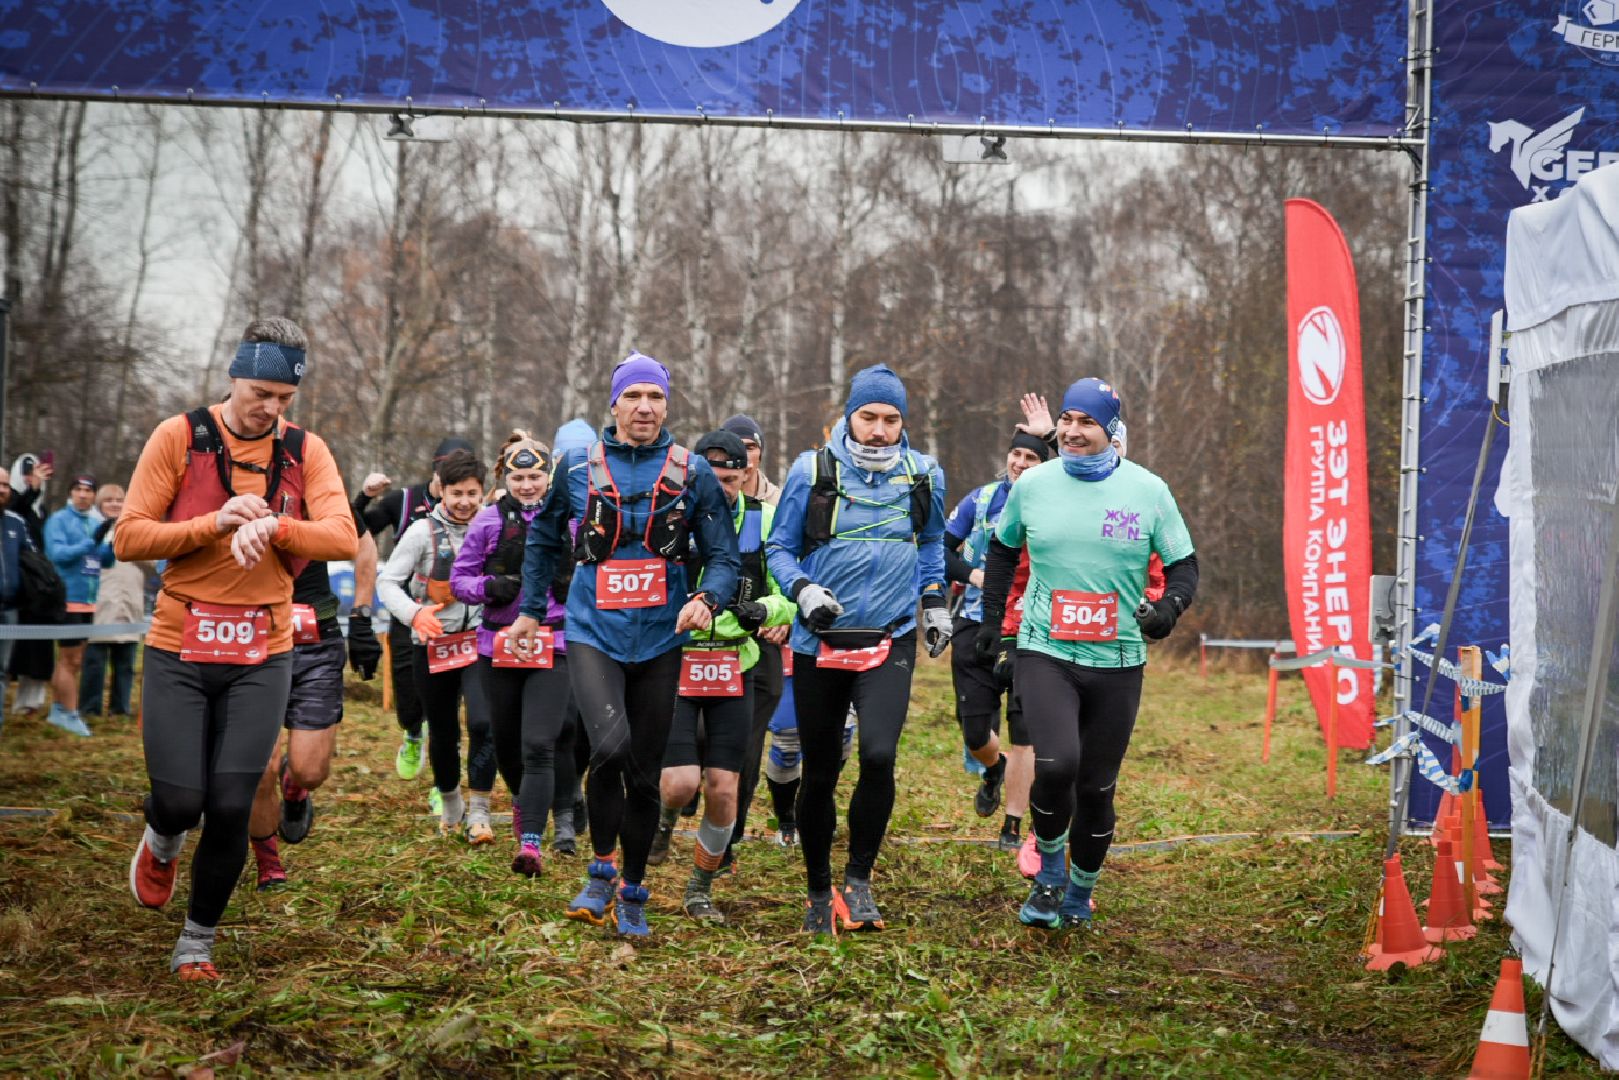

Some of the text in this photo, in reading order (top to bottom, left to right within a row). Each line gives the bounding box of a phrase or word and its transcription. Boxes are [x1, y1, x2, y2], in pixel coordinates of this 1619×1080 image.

[1581, 30, 1619, 48] ГЕР
[1326, 419, 1349, 506] ЗЭТ
[1309, 425, 1326, 522] ГРУППА
[607, 573, 654, 593] 507
[1062, 605, 1108, 625] 504
[197, 620, 254, 644] 509
[436, 641, 473, 659] 516
[689, 664, 732, 681] 505
